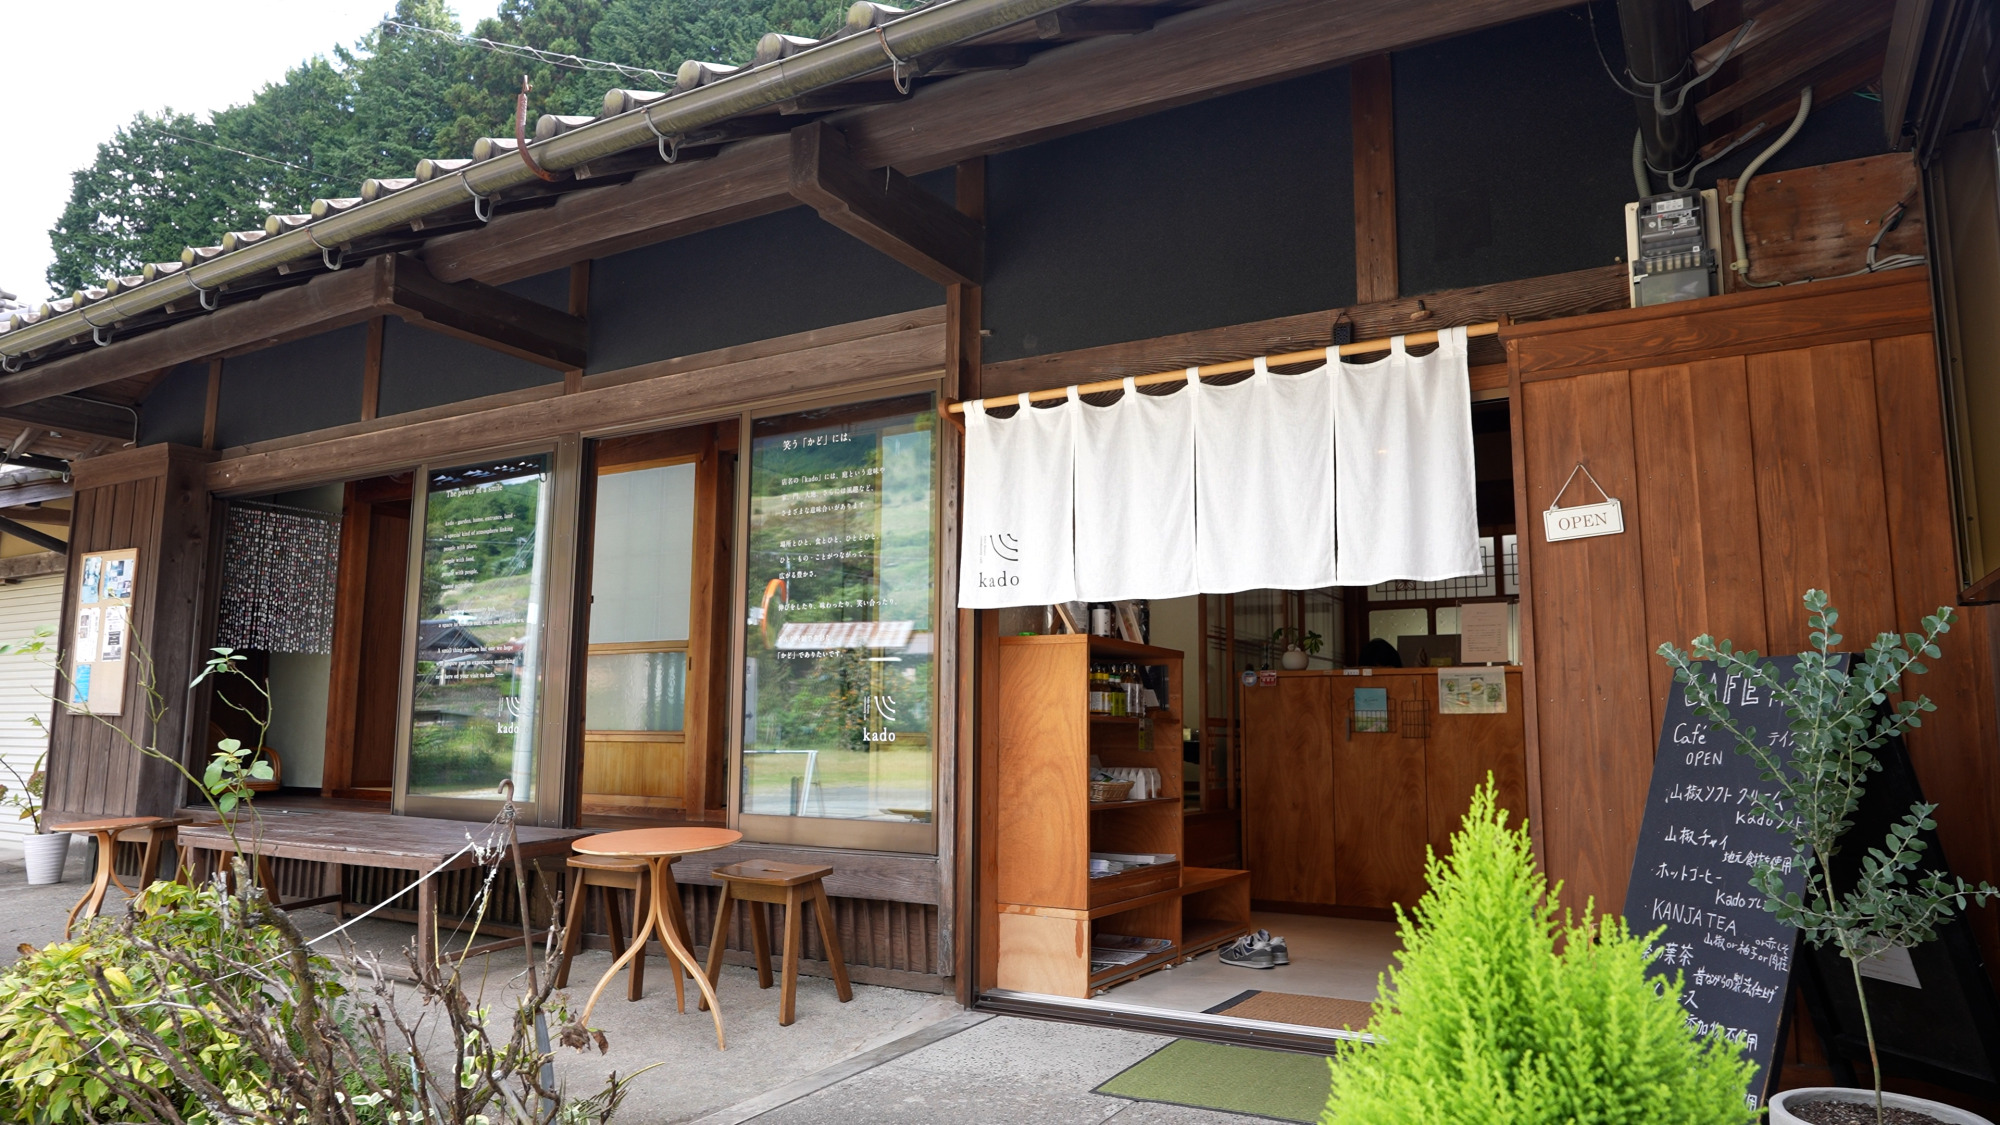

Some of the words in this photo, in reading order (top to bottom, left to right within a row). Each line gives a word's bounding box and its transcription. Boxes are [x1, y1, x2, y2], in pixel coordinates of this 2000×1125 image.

[782, 433, 852, 451] 笑う「かど」には、
[447, 490, 457, 498] The
[458, 488, 475, 497] power
[488, 483, 503, 492] smile
[1558, 512, 1607, 531] OPEN
[979, 570, 1020, 588] kado
[496, 721, 520, 734] kado
[862, 726, 896, 742] kado
[1673, 722, 1707, 745] Café
[1685, 750, 1723, 767] OPEN
[1664, 825, 1729, 850] 山椒チャイ
[1656, 861, 1722, 885] ホットコーヒー
[1652, 897, 1702, 927] KANJA
[1706, 912, 1737, 936] TEA
